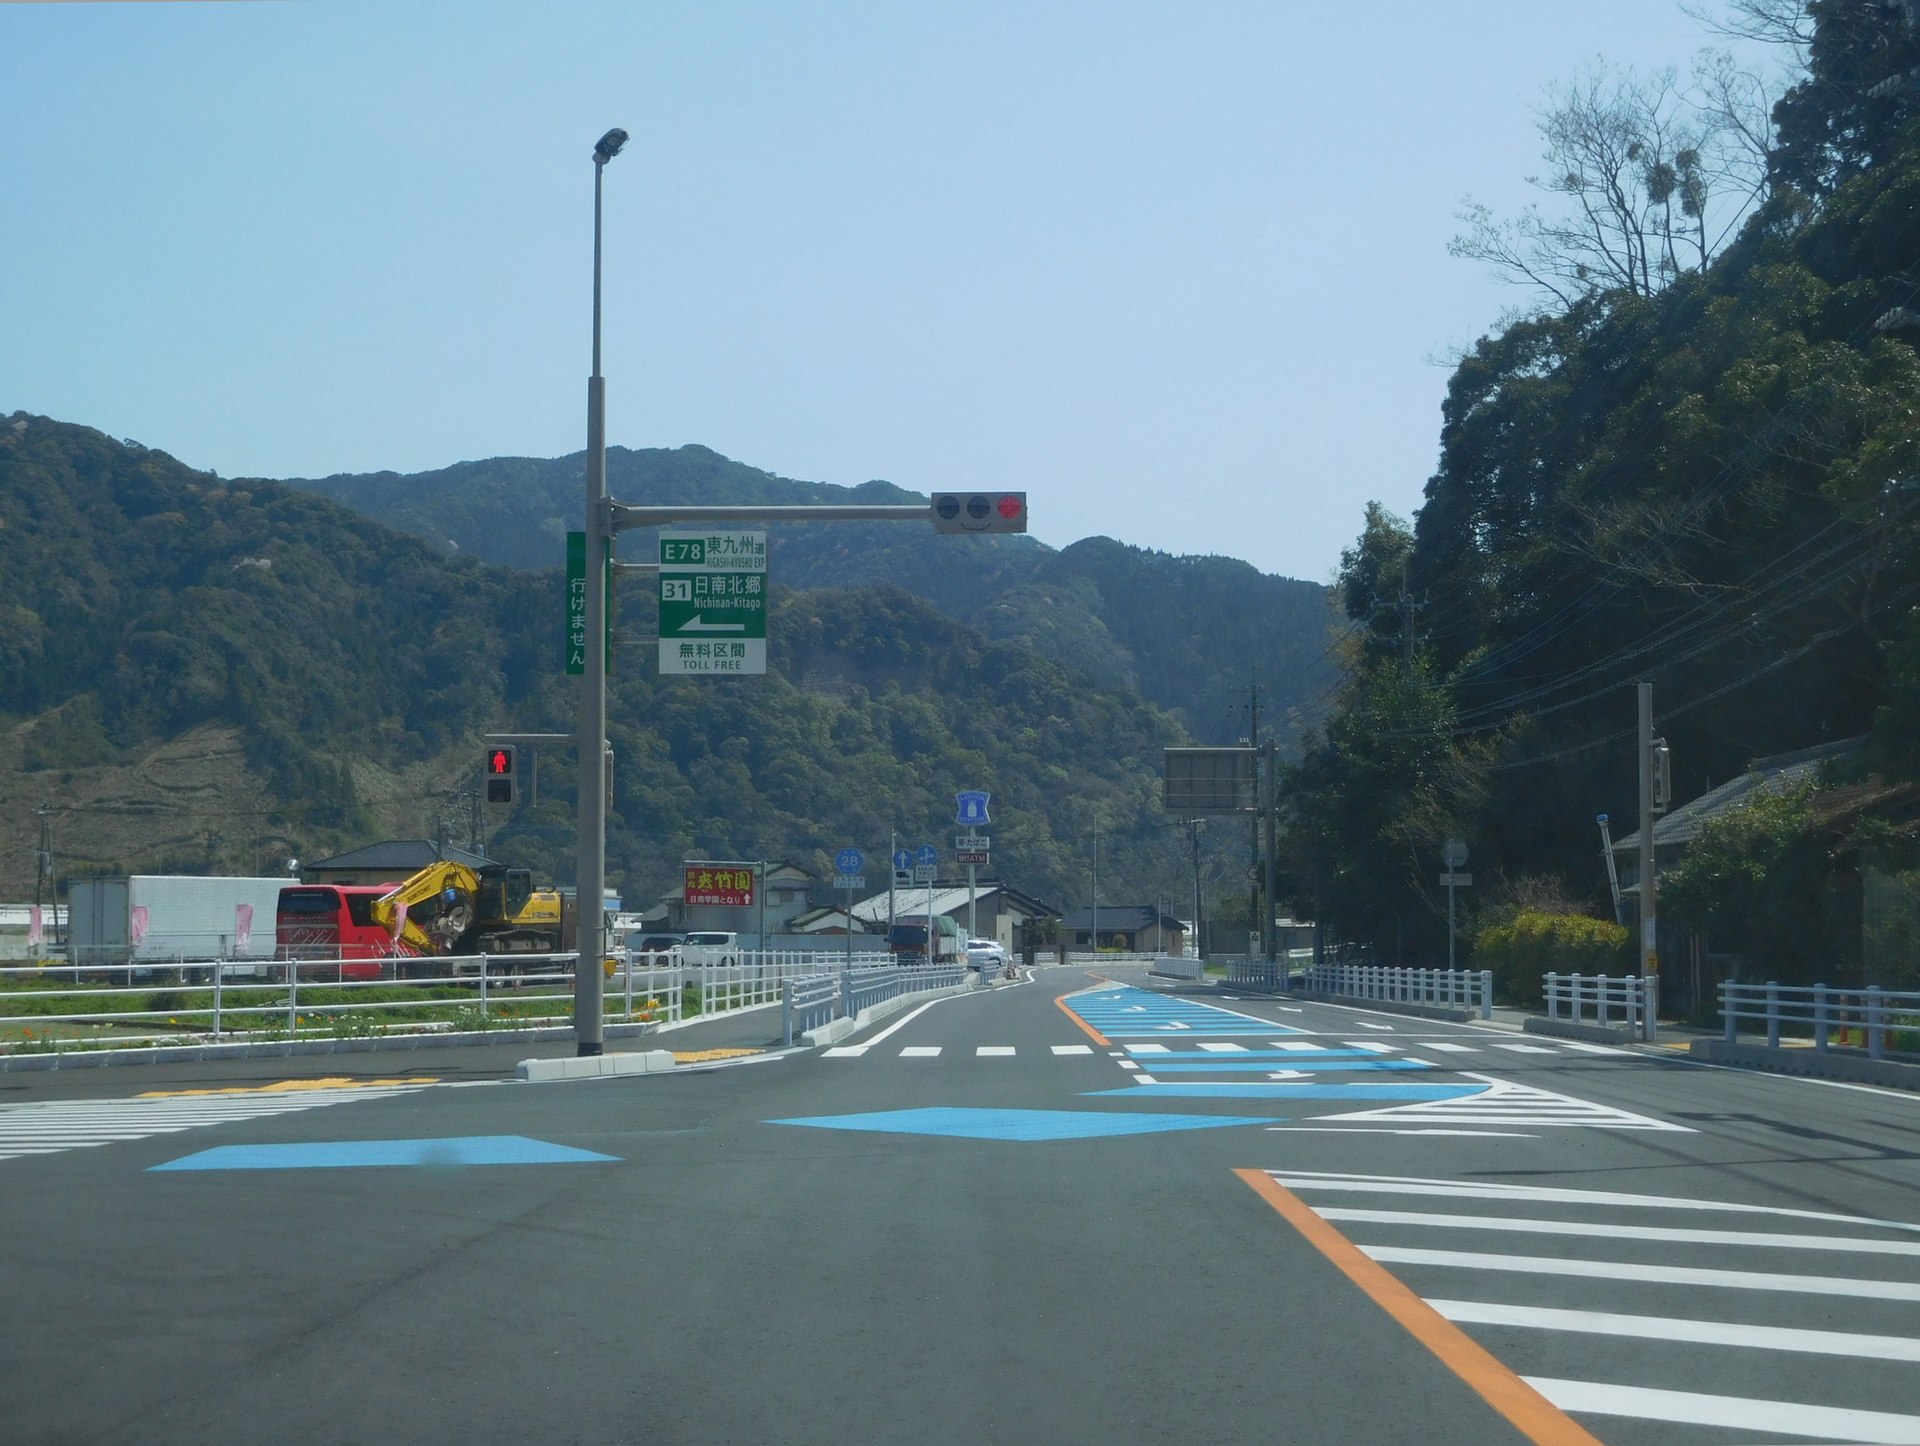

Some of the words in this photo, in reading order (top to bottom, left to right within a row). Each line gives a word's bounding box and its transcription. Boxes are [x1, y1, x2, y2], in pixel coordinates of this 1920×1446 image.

[665, 544, 701, 560] E78
[706, 536, 765, 555] 東九州道
[706, 557, 752, 568] HIGASHI-KYUSHU
[754, 557, 765, 568] EXP
[664, 583, 687, 598] 31
[695, 576, 761, 595] 日南北郷
[694, 596, 761, 611] Nichinan-Kitago
[570, 577, 586, 665] 行けません
[679, 643, 745, 659] 無料区間
[683, 660, 710, 670] TOLL
[715, 660, 741, 670] FREE
[841, 855, 858, 867] 28
